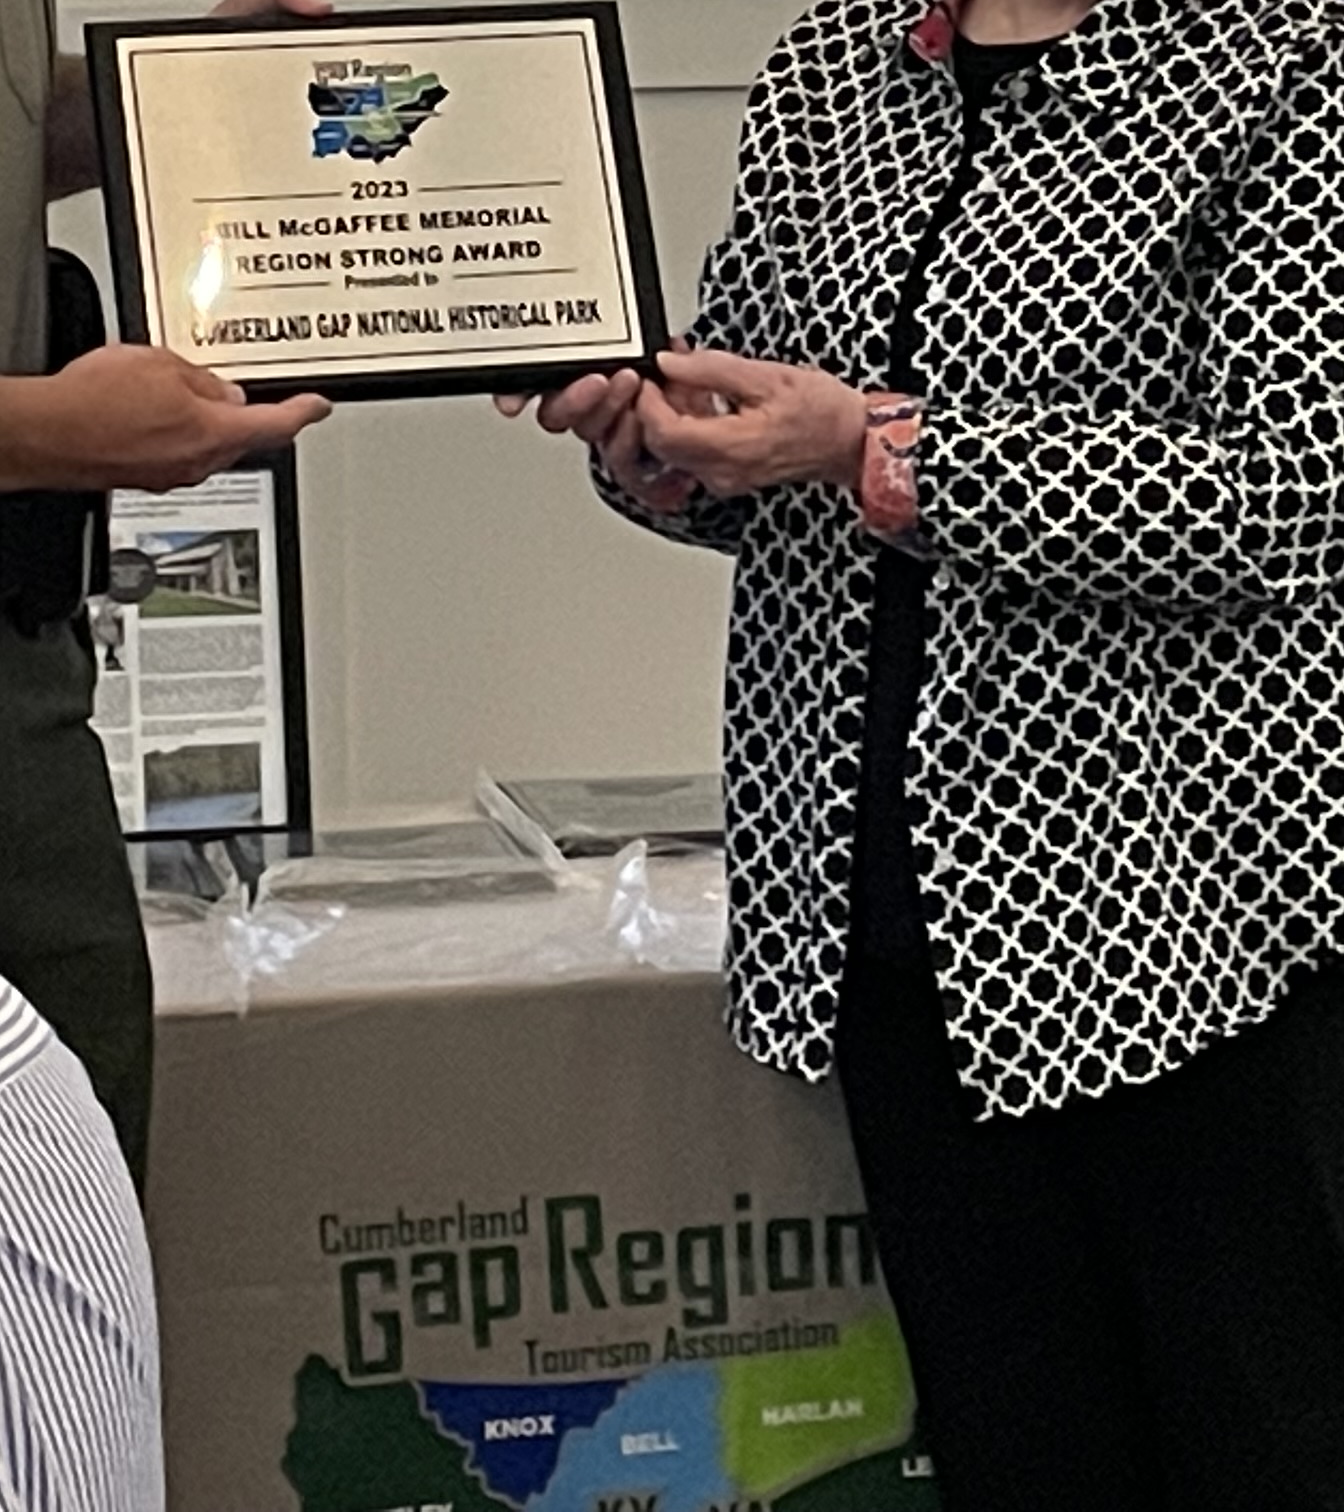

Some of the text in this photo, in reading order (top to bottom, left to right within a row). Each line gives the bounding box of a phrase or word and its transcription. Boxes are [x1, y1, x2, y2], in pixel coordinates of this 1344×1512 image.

[351, 180, 409, 200] 2023
[279, 212, 410, 236] McGAFFEE
[419, 206, 551, 229] MEMORIAL
[236, 240, 542, 273] REGION STRONG AWARD
[316, 312, 352, 338] GAP
[356, 307, 445, 337] NATIONAL
[448, 301, 552, 332] HISTORICAL
[554, 298, 602, 326] PARK
[318, 1193, 530, 1255] Cumberland
[340, 1192, 878, 1377] Gap Region
[525, 1317, 840, 1376] Tourism Association
[483, 1414, 555, 1441] KNOX
[761, 1398, 865, 1427] HARLAN
